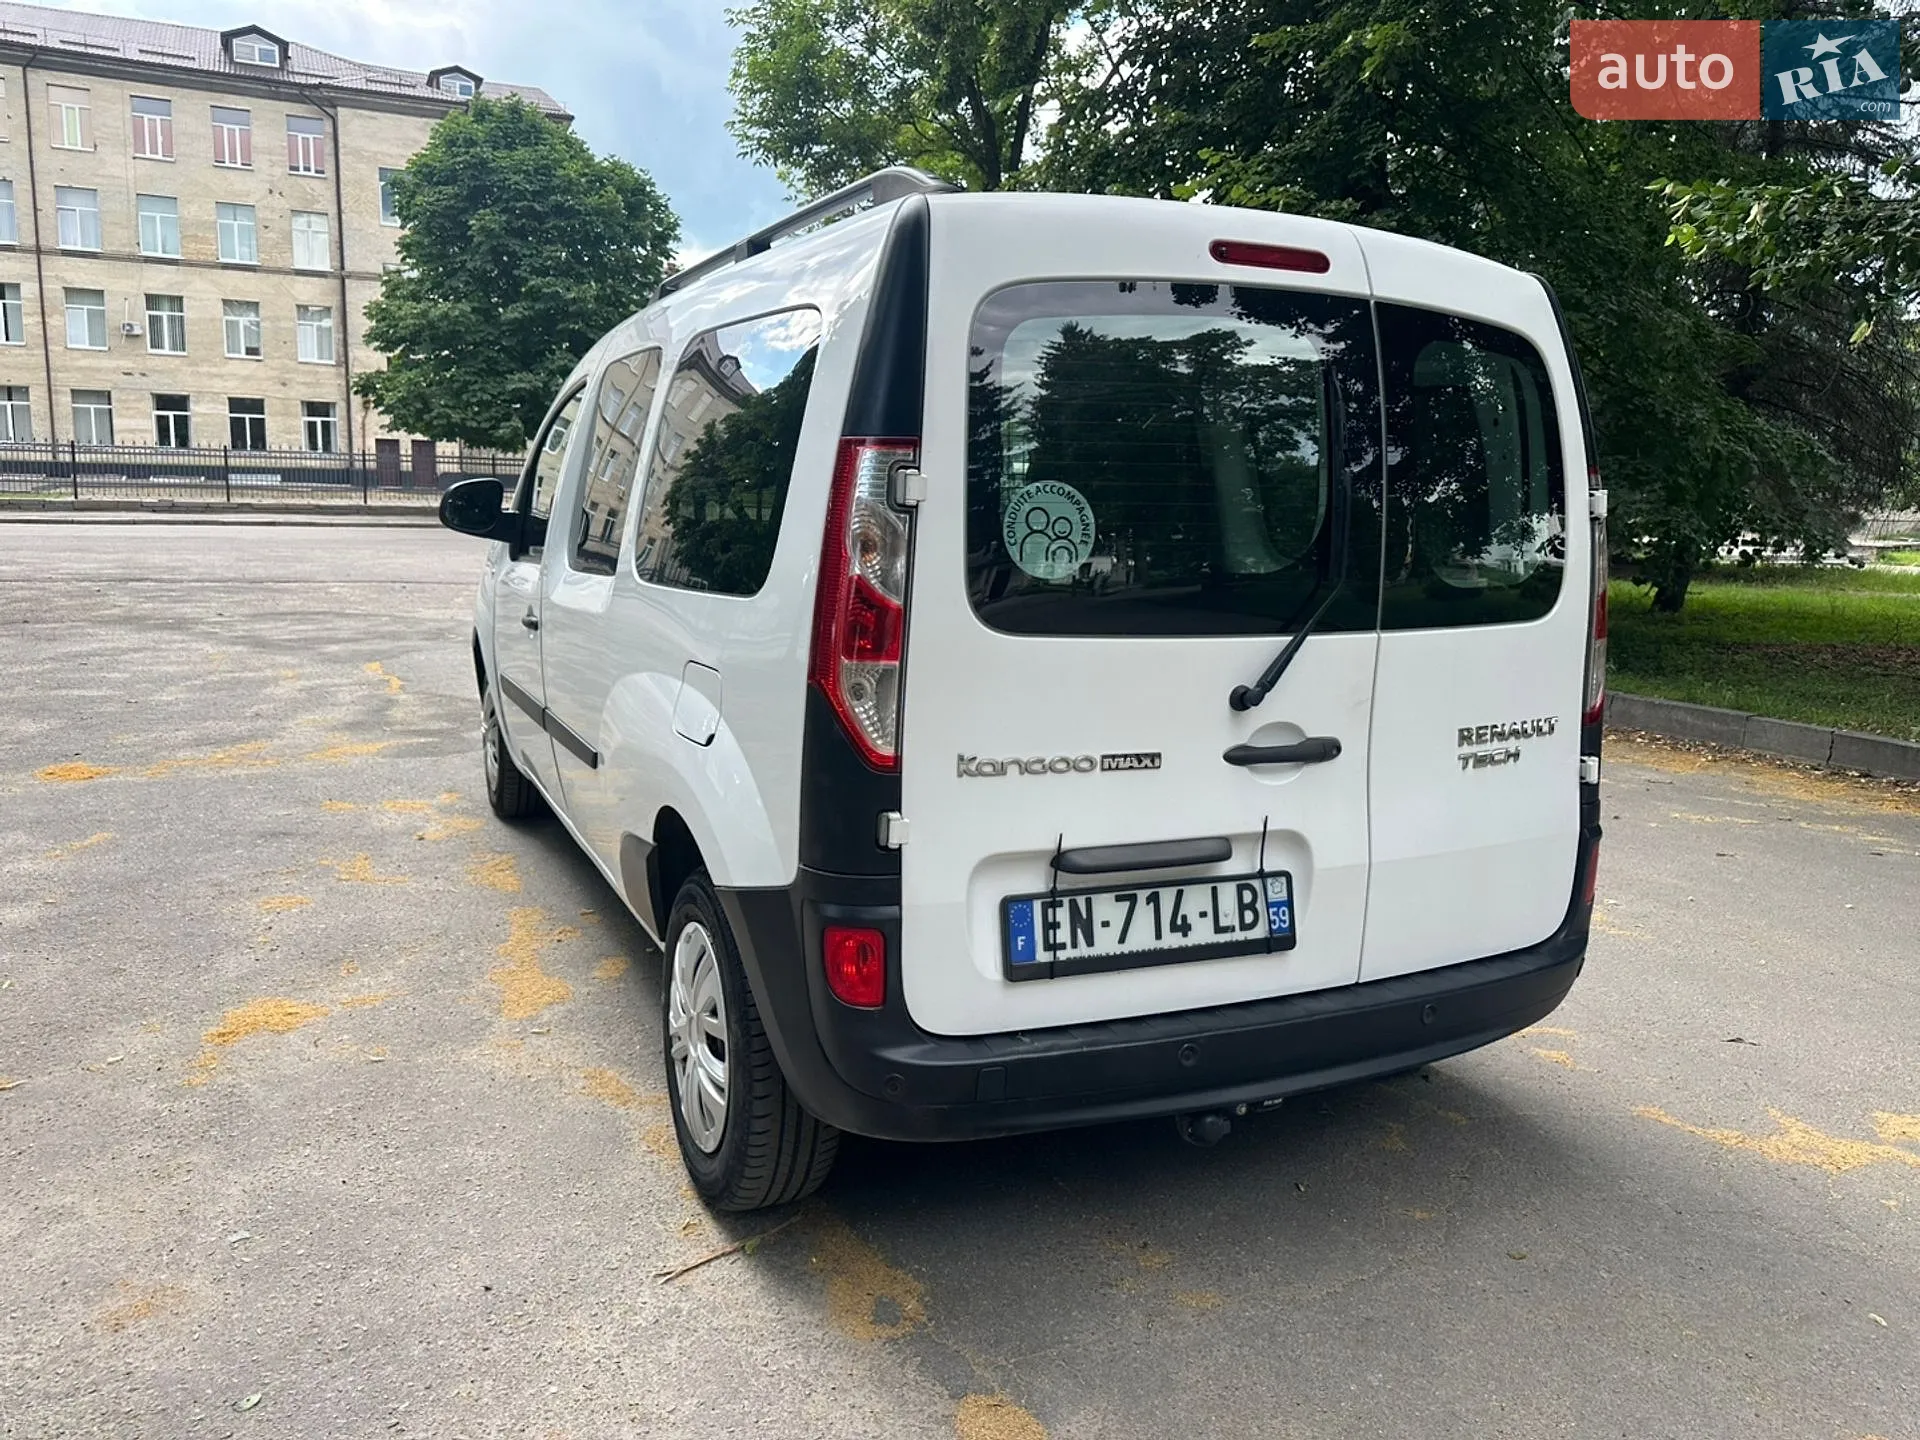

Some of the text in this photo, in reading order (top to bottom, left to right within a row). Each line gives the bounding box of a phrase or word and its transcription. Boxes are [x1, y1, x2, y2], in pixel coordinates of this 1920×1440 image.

[1006, 489, 1035, 547] CONDUITE
[1457, 716, 1559, 748] RENAULT
[1102, 754, 1161, 770] MAXI
[1457, 746, 1521, 771] TECH
[1017, 935, 1027, 951] F
[1041, 882, 1260, 952] EN-714-LB
[1269, 905, 1291, 930] 59
